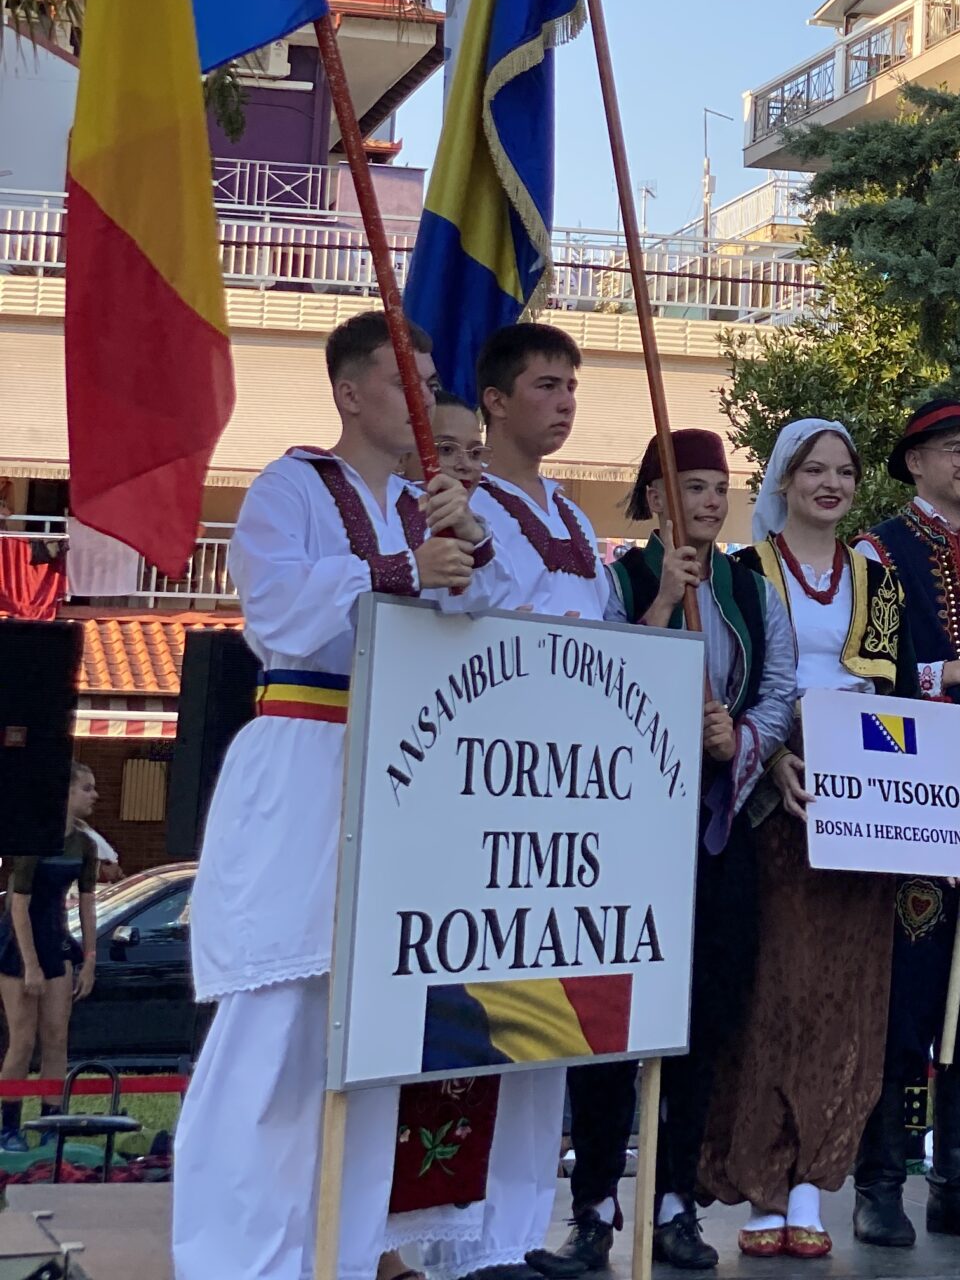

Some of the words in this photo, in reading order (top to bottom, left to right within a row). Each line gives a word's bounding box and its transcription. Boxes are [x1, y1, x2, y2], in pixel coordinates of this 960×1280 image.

[386, 635, 529, 807] ANSAMBLUL
[456, 736, 633, 801] TORMAC
[813, 773, 863, 799] KUD
[815, 819, 863, 838] BOSNA
[866, 823, 871, 838] I
[482, 831, 600, 889] TIMIS
[392, 904, 665, 976] ROMANIA
